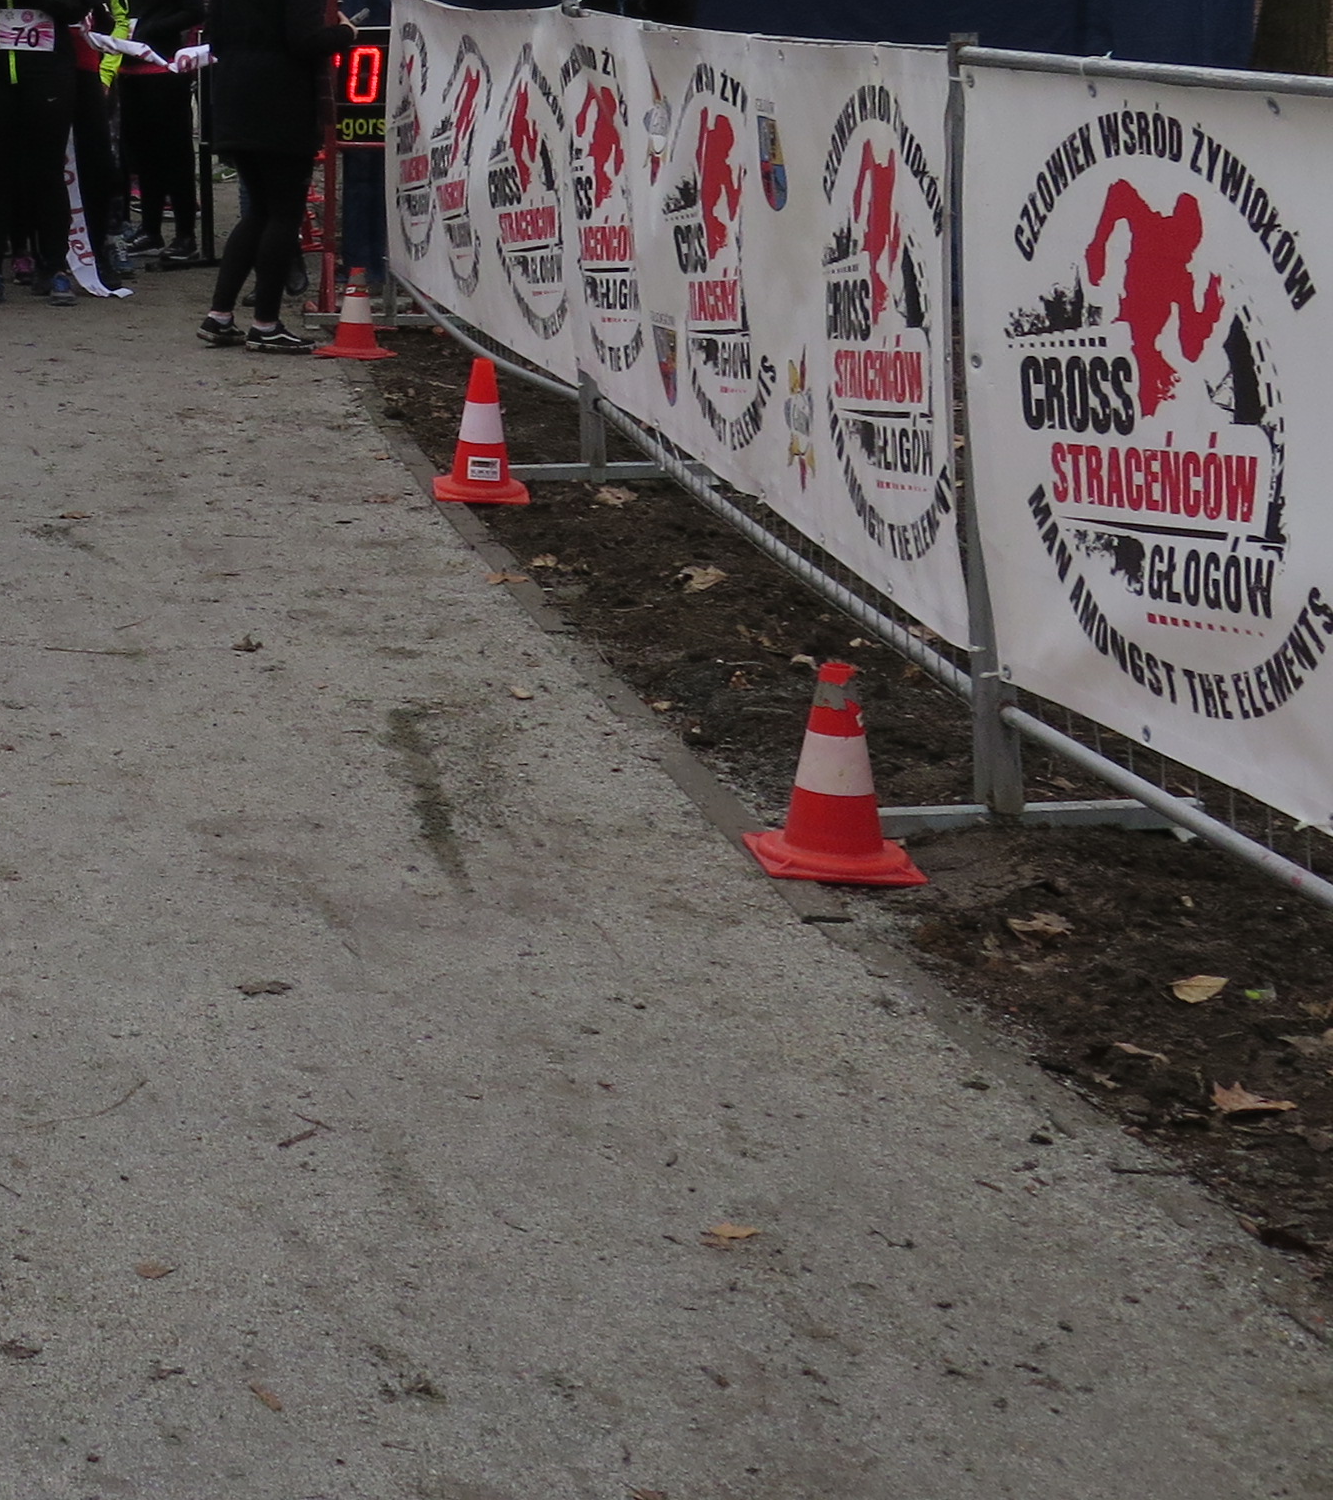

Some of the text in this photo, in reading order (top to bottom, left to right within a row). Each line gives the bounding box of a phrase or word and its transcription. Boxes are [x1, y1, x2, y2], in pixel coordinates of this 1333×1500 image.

[11, 26, 40, 48] 70
[1013, 99, 1317, 311] CZŁOWIEK WŚRÓD ŻYWIOŁÓW
[1019, 355, 1135, 435] CROSS
[1050, 431, 1259, 523] STRACEŃCÓW
[1027, 483, 1333, 722] MAN AMONGST THE ELEMENTS
[1147, 535, 1276, 619] GŁOGÓW
